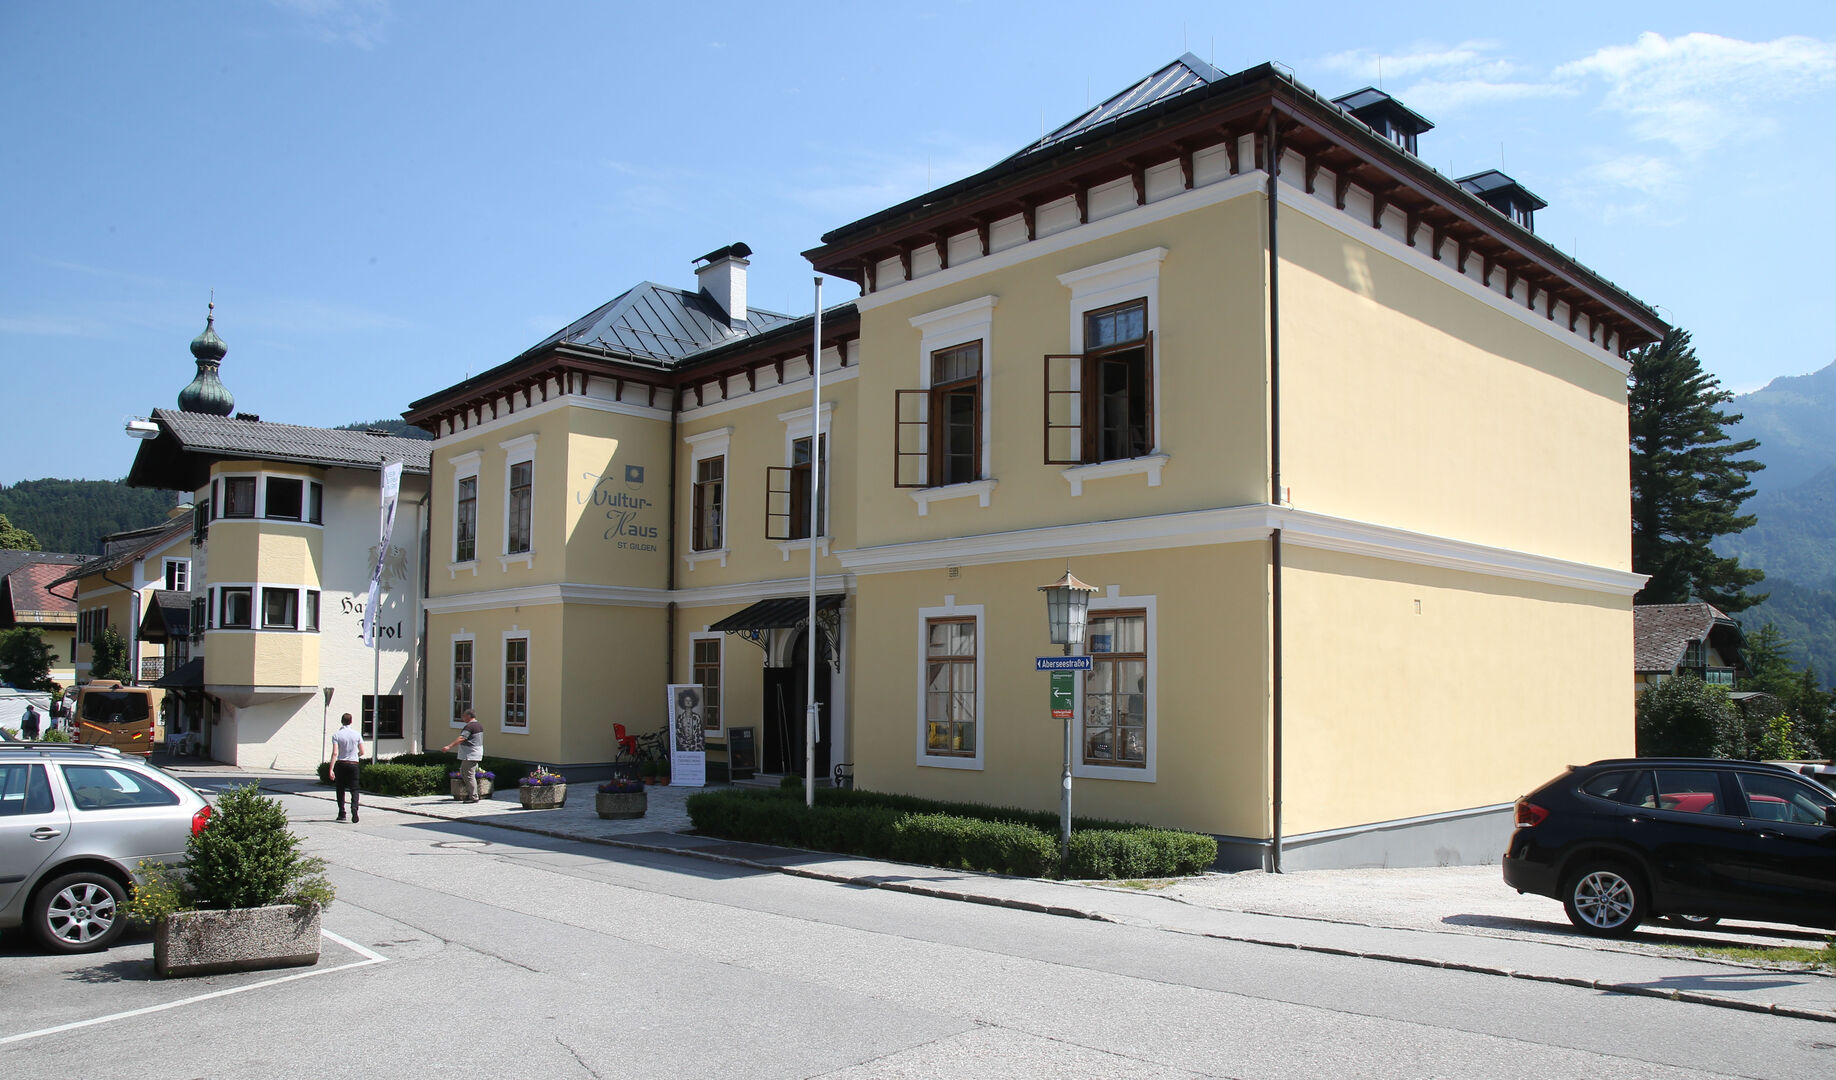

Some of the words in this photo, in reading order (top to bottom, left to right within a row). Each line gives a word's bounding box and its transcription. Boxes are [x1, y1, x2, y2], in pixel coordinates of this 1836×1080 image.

[603, 509, 658, 540] Haus
[629, 542, 657, 552] GILGEN
[1042, 659, 1085, 668] Aberseestraße
